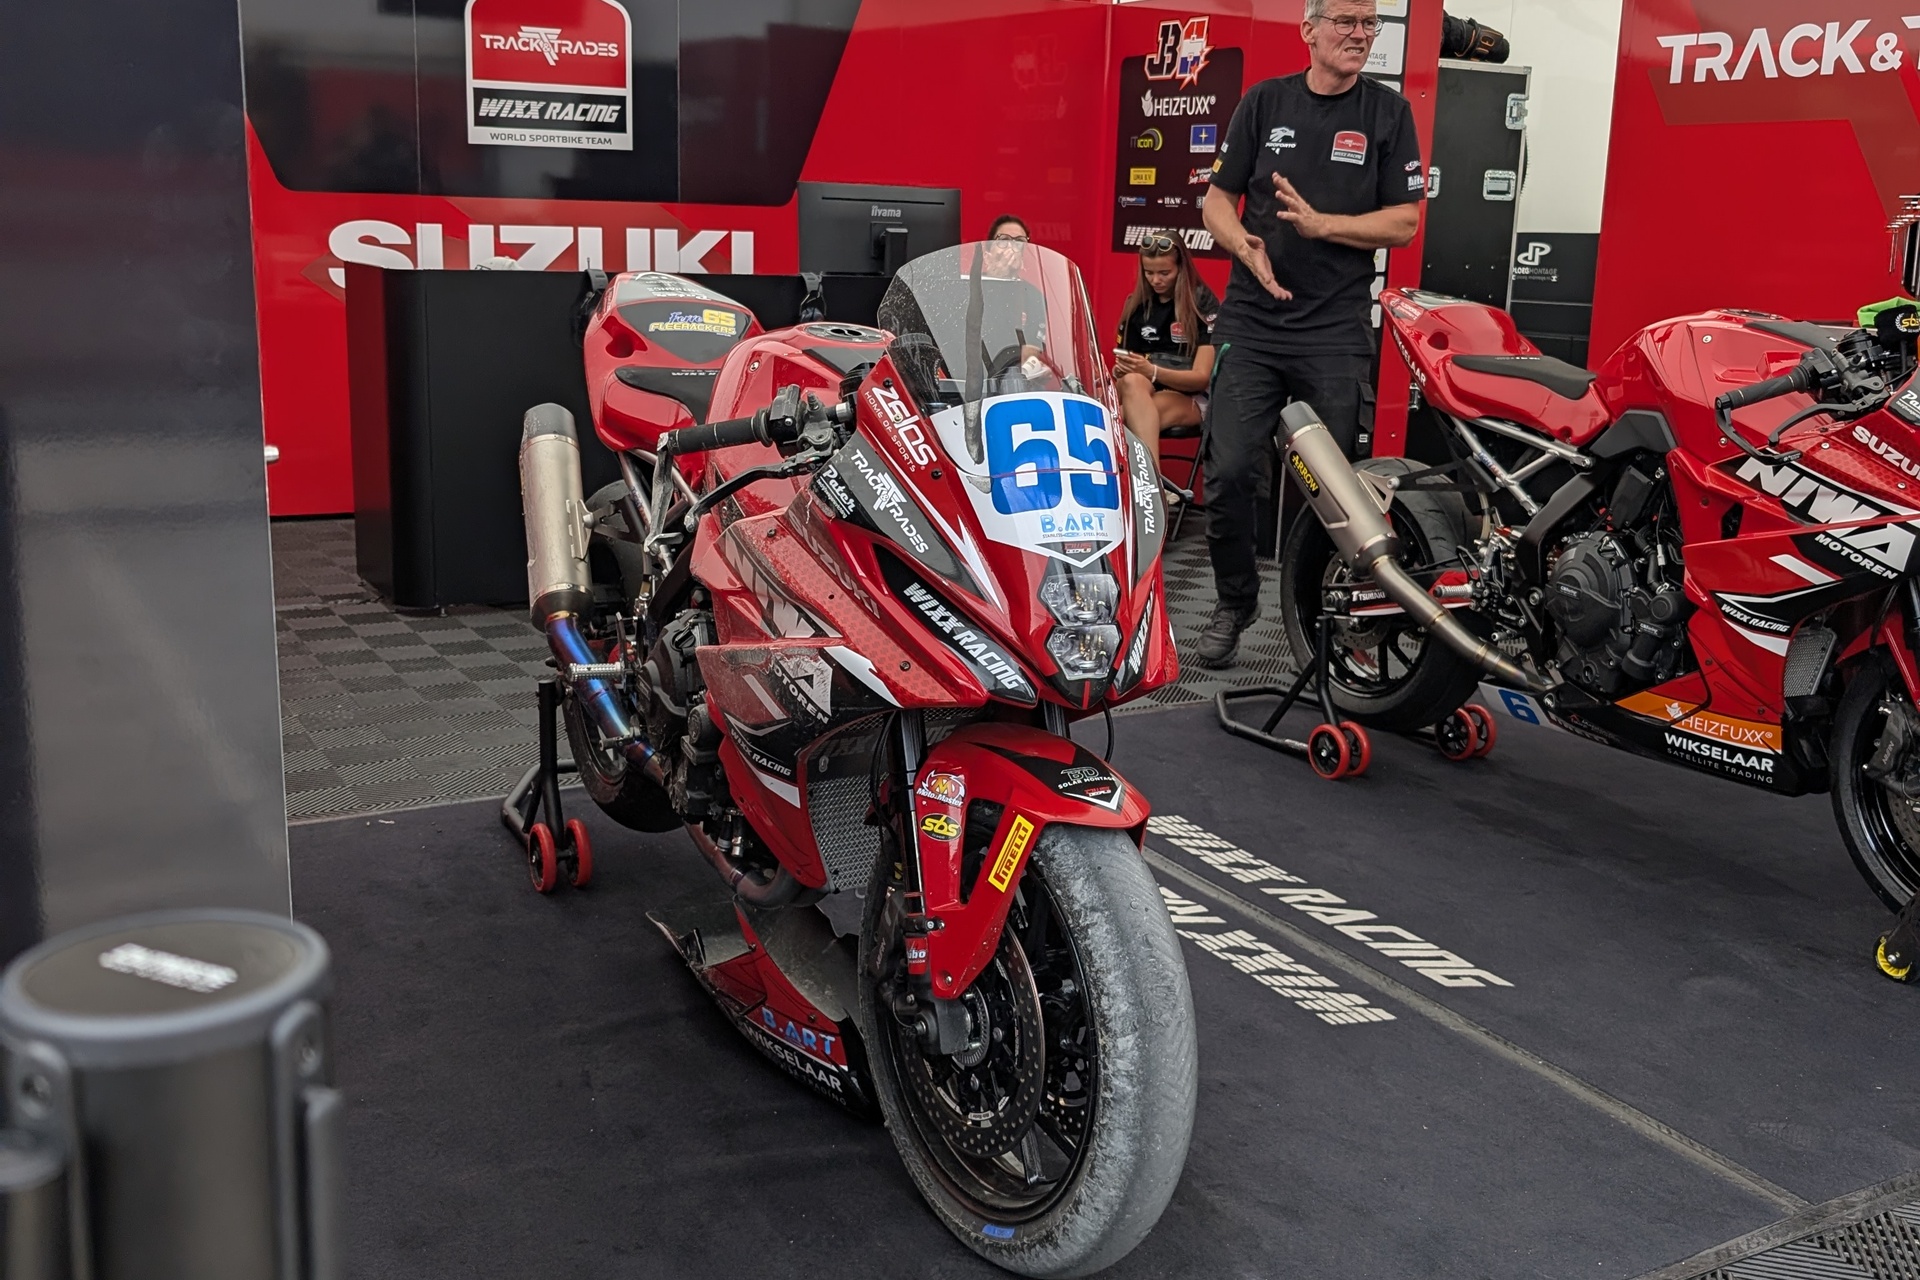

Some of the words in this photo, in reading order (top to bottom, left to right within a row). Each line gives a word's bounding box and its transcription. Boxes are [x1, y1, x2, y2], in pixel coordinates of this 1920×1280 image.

[478, 98, 546, 120] WIXX
[544, 102, 621, 123] RACING
[490, 132, 527, 142] WORLD
[529, 134, 584, 145] SPORTBIKE
[585, 136, 613, 145] TEAM
[703, 309, 737, 328] 65
[864, 391, 885, 422] HOME
[882, 420, 892, 436] OF
[891, 434, 917, 473] SPORTS
[984, 397, 1122, 516] 65
[1852, 425, 1920, 482] SUZU
[822, 464, 856, 513] Pater
[1291, 455, 1319, 492] ARROW
[1040, 512, 1106, 533] B.ART
[1814, 534, 1899, 581] MOTOREN
[903, 582, 964, 634] WIXX
[952, 629, 1025, 690] RACING
[1720, 603, 1751, 624] WIXX
[1749, 617, 1791, 634] RACING
[773, 662, 830, 725] OTOREN
[1498, 689, 1541, 725] 6
[752, 753, 792, 777] RACING
[1664, 732, 1774, 773] WIKSELAAR
[1667, 747, 1719, 769] SATELLITE
[1725, 765, 1773, 784] TRADING
[1058, 780, 1083, 790] SOLAR
[921, 815, 960, 837] sbs
[994, 821, 1029, 886] PIRELLI
[1259, 888, 1515, 988] RACING
[761, 1006, 836, 1056] B.ART
